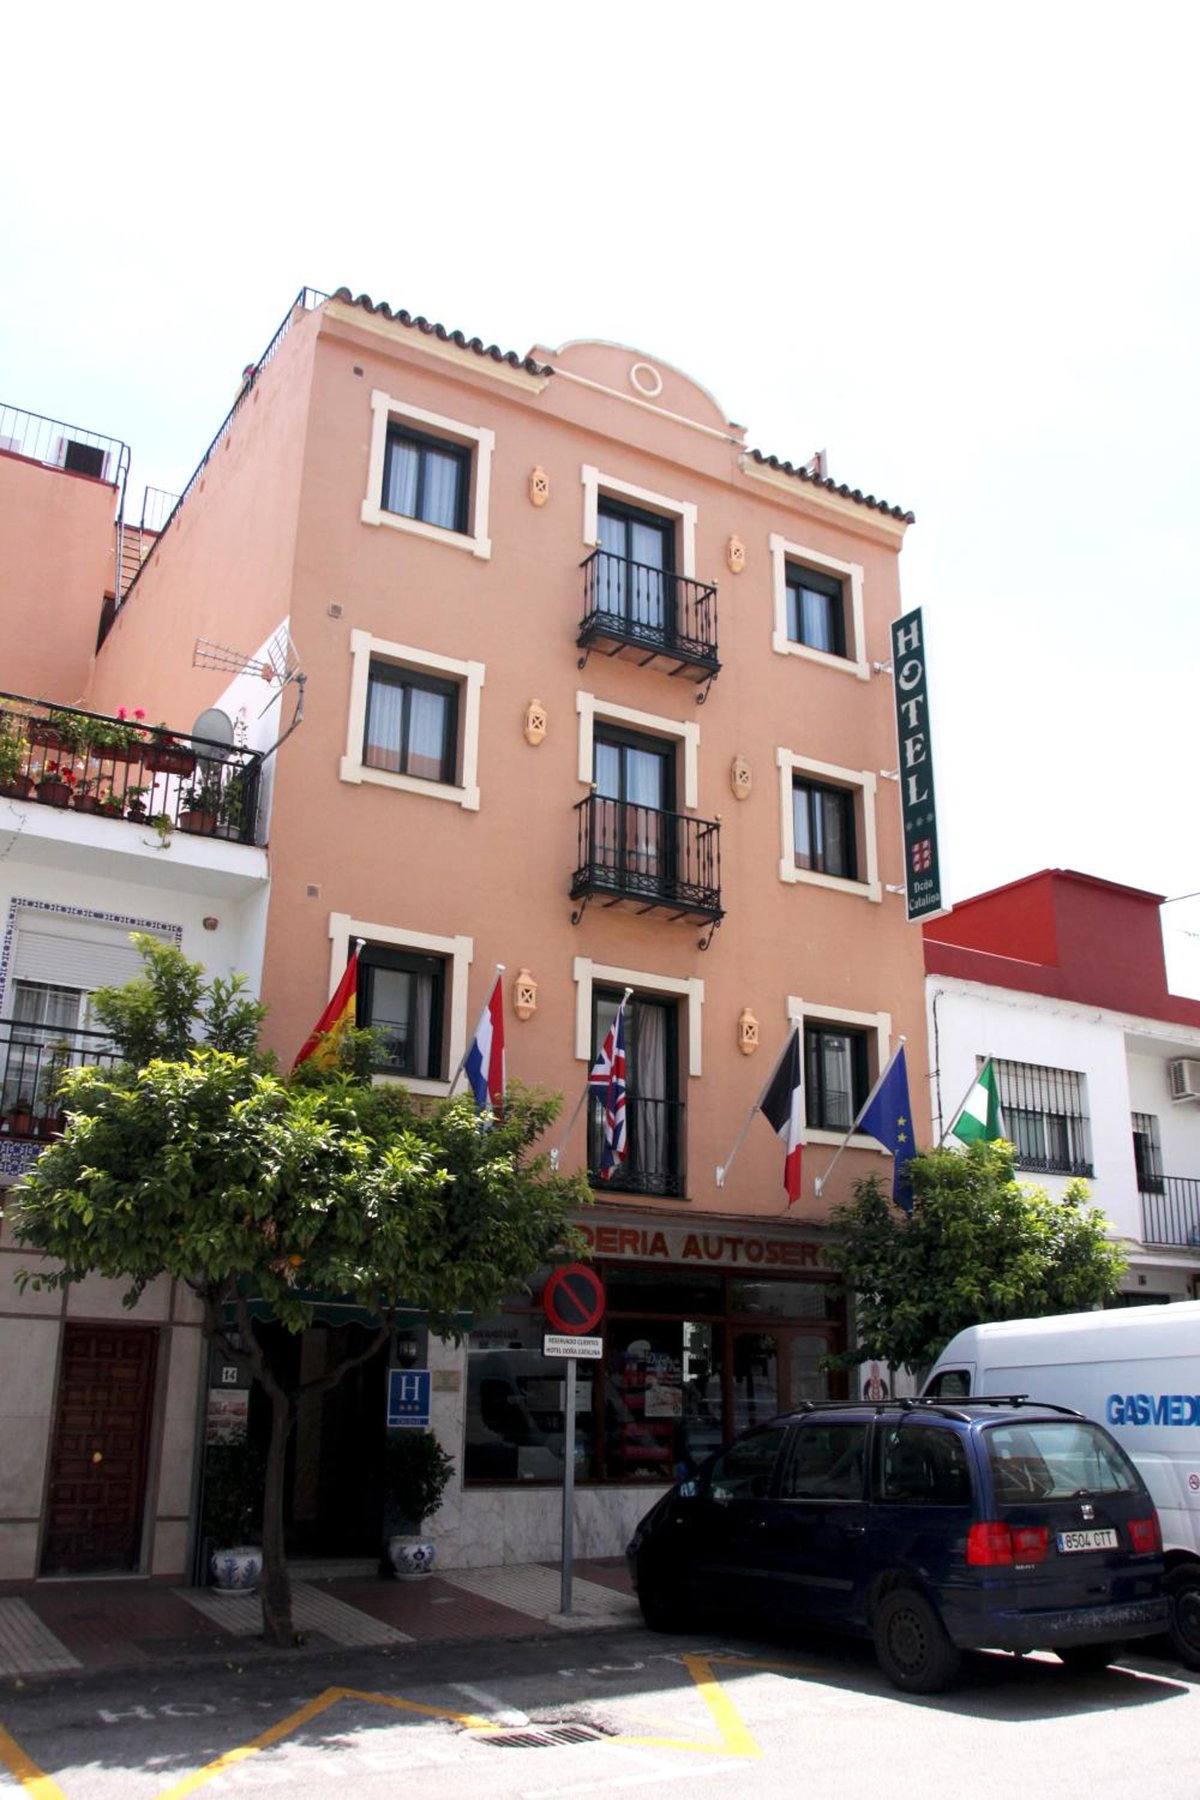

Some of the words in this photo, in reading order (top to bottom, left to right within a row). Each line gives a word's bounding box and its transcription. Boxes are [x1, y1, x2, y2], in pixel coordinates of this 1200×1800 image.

[897, 619, 928, 807] HOTEL
[909, 893, 940, 911] Catalina
[224, 1370, 236, 1381] 14
[400, 1375, 420, 1401] H
[1065, 1533, 1091, 1548] 8504
[1093, 1531, 1112, 1545] CTT
